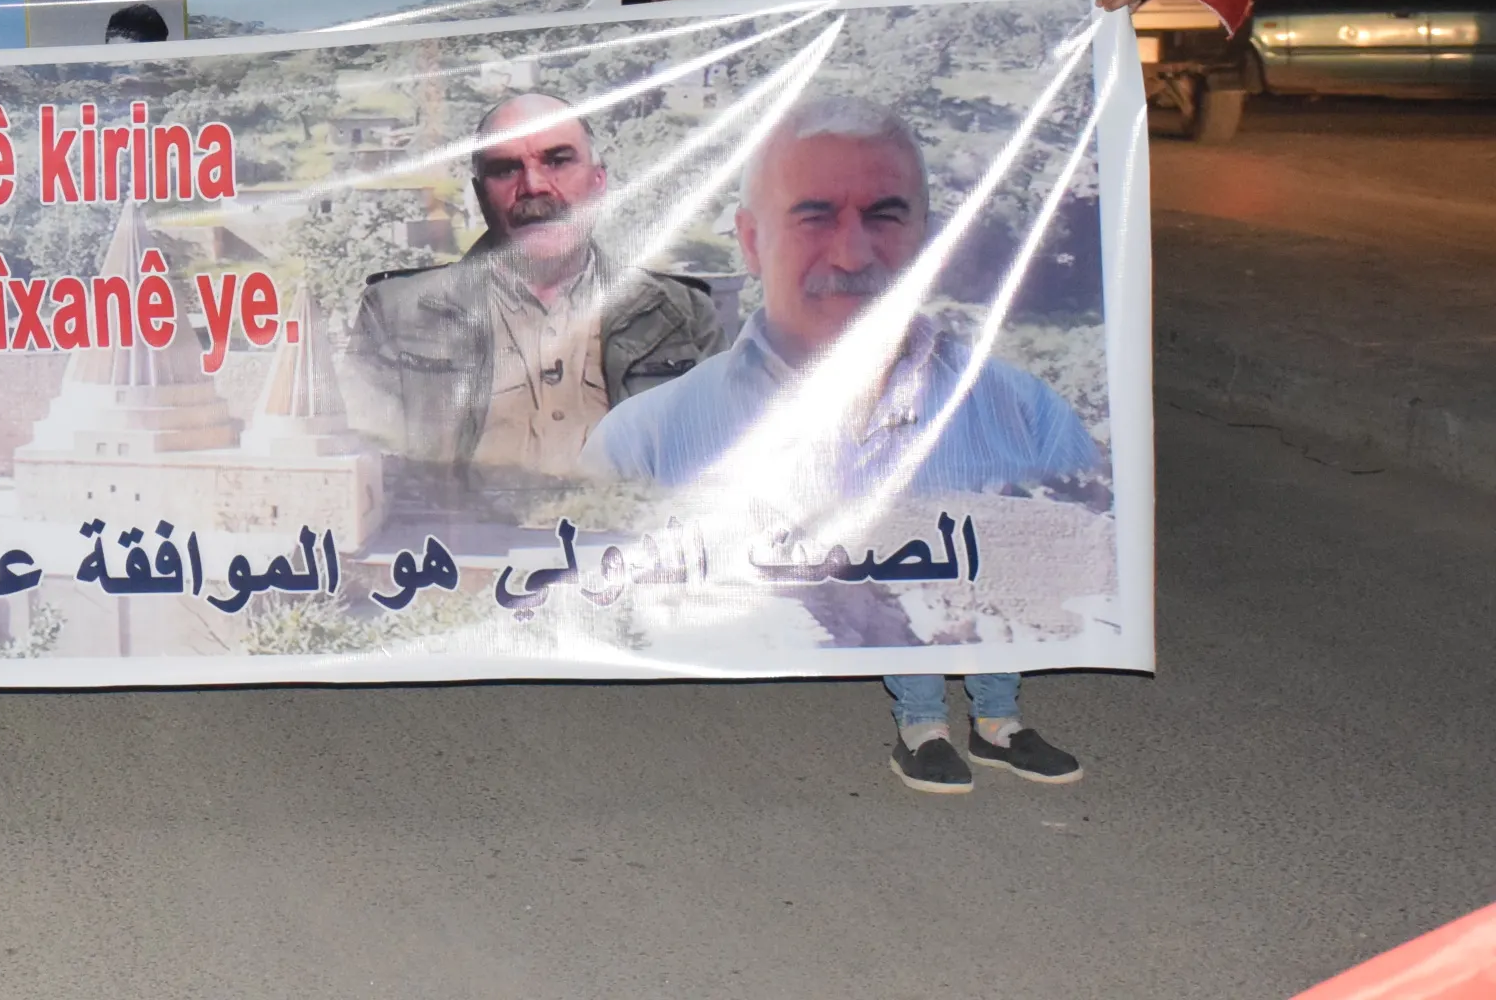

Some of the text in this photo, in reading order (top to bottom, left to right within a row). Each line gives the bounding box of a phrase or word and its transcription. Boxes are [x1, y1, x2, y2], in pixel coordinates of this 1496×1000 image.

[39, 101, 236, 204] kirina
[196, 270, 300, 375] ye.
[76, 517, 340, 614] الموافقة
[371, 534, 459, 614] هو
[749, 511, 979, 582] الصمت
